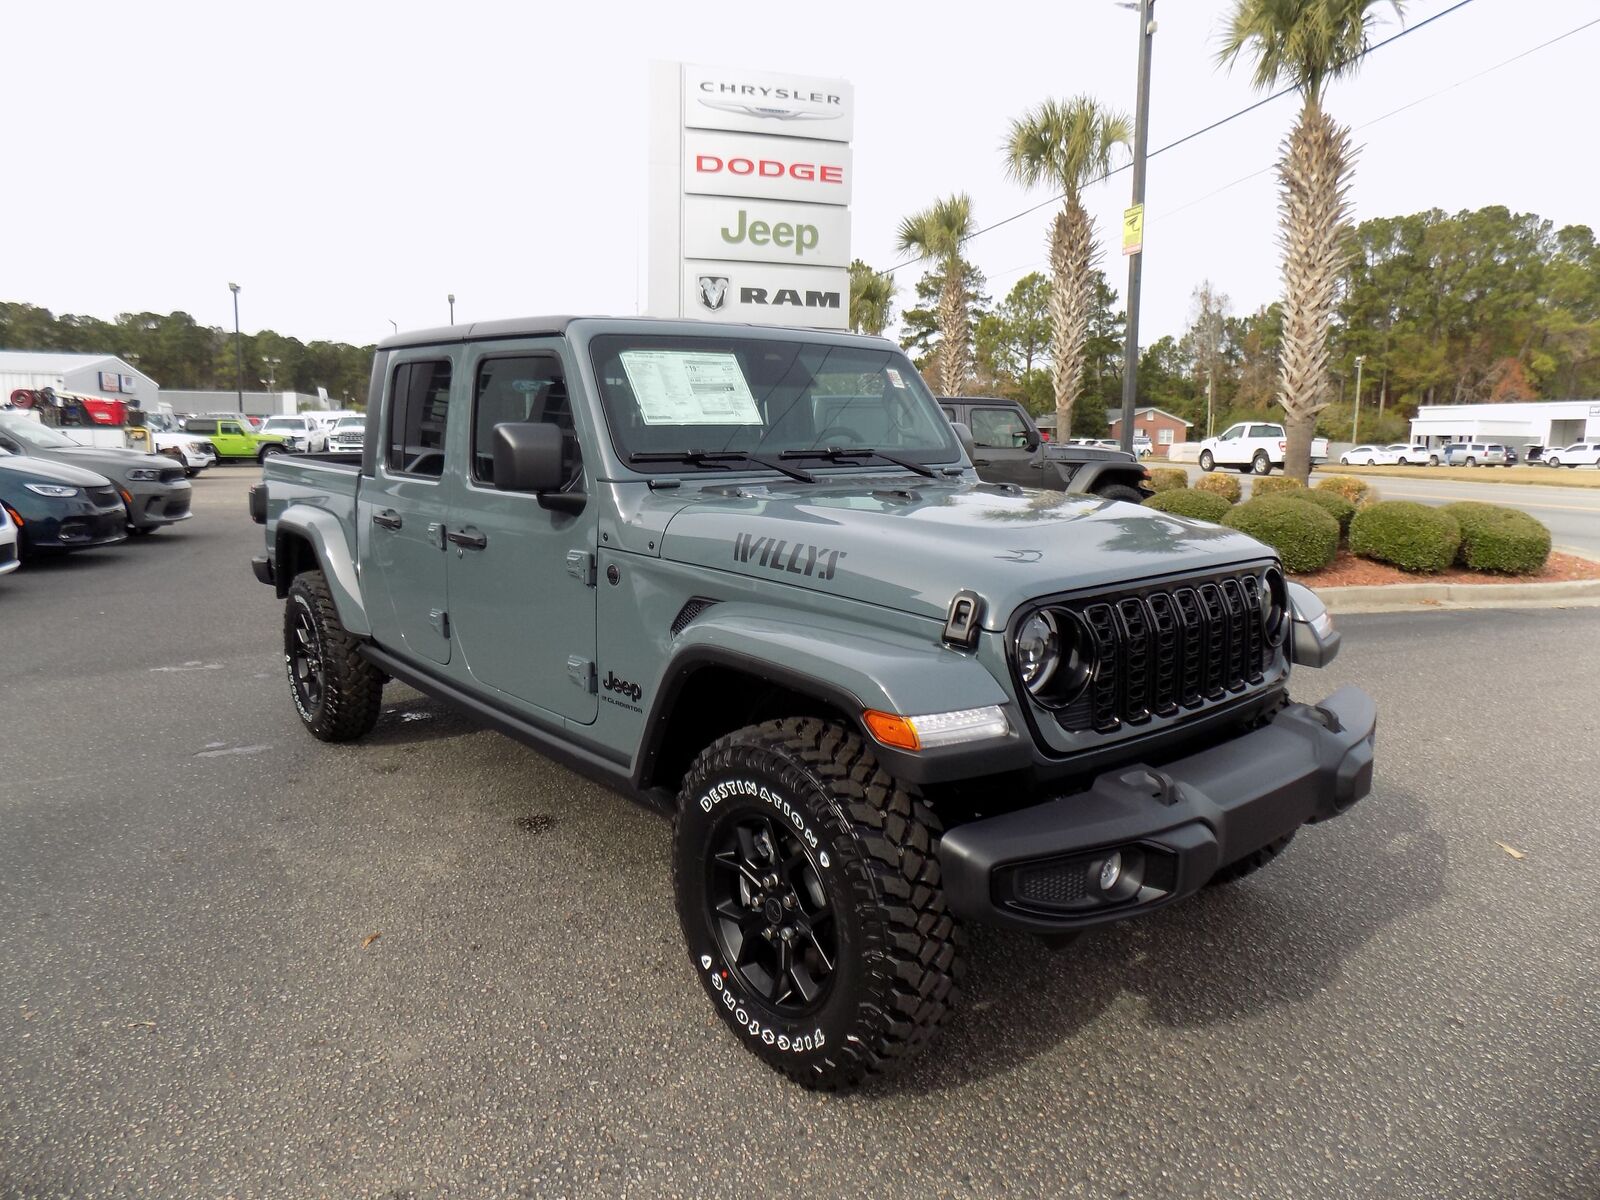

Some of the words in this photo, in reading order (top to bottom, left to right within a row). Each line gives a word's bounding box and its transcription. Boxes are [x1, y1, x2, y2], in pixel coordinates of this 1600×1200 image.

[699, 81, 841, 105] CHRYSLER
[696, 155, 843, 184] DODGE
[720, 209, 819, 256] Jeep
[740, 287, 841, 309] RAM
[733, 532, 847, 580] WILLYS
[602, 670, 643, 703] Jeep
[607, 697, 643, 715] GLADIATOR
[699, 780, 818, 849] DESTINATION
